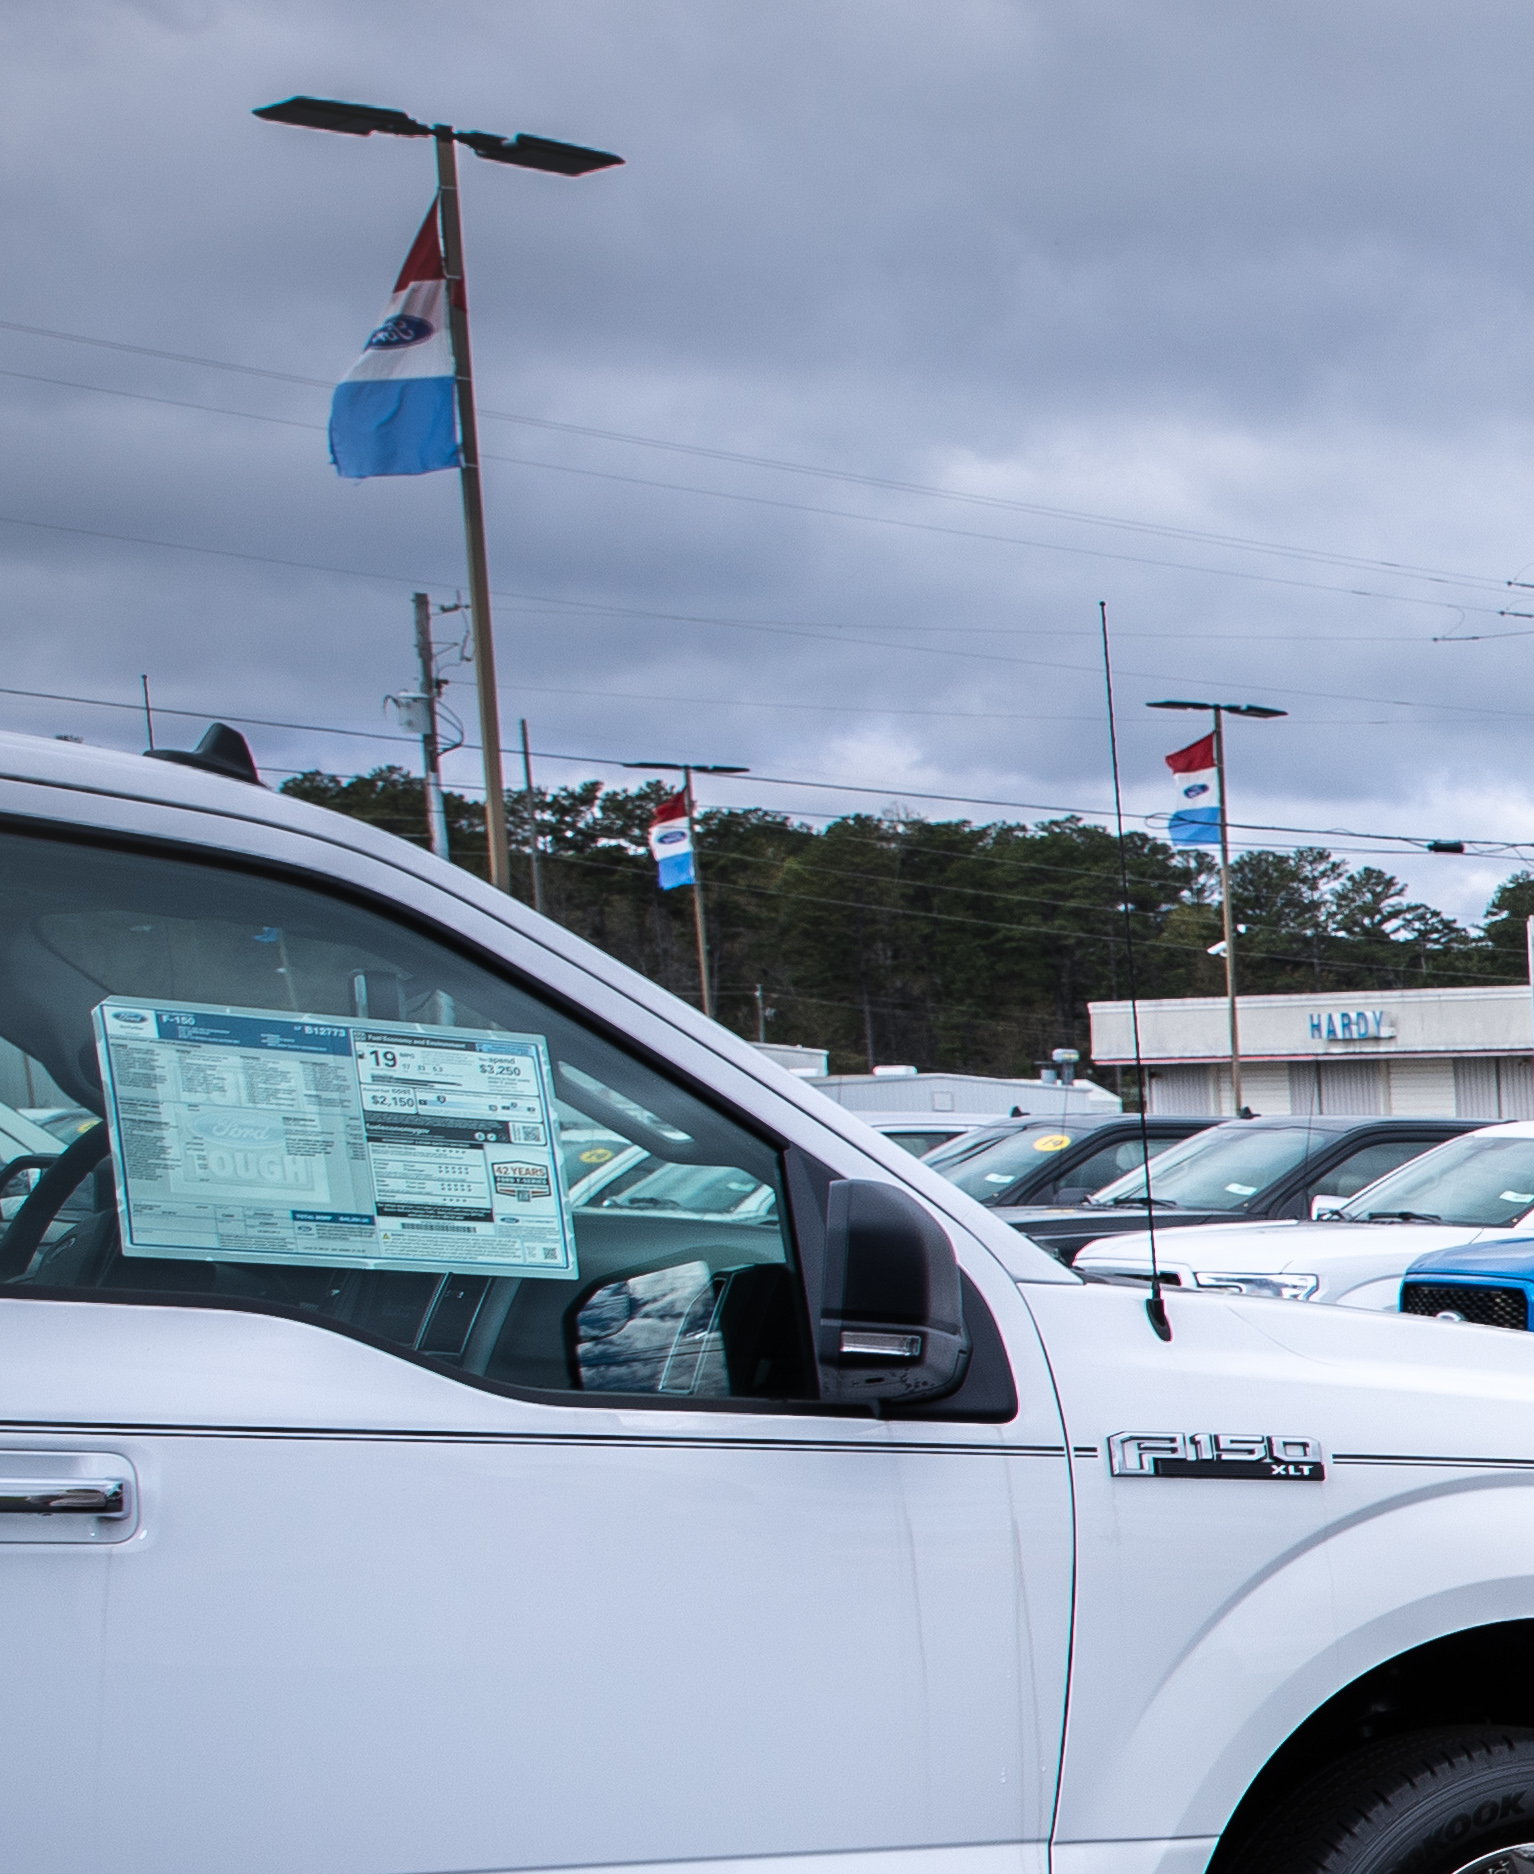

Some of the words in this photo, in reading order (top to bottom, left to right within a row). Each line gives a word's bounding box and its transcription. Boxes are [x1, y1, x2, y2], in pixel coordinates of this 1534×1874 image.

[161, 1014, 196, 1026] F-150
[1308, 1010, 1383, 1040] HARDY
[369, 1049, 397, 1068] 19
[479, 1064, 521, 1077] $3,250
[371, 1094, 415, 1108] $2,150
[510, 1166, 546, 1177] YEARS
[1270, 1464, 1314, 1476] XLT
